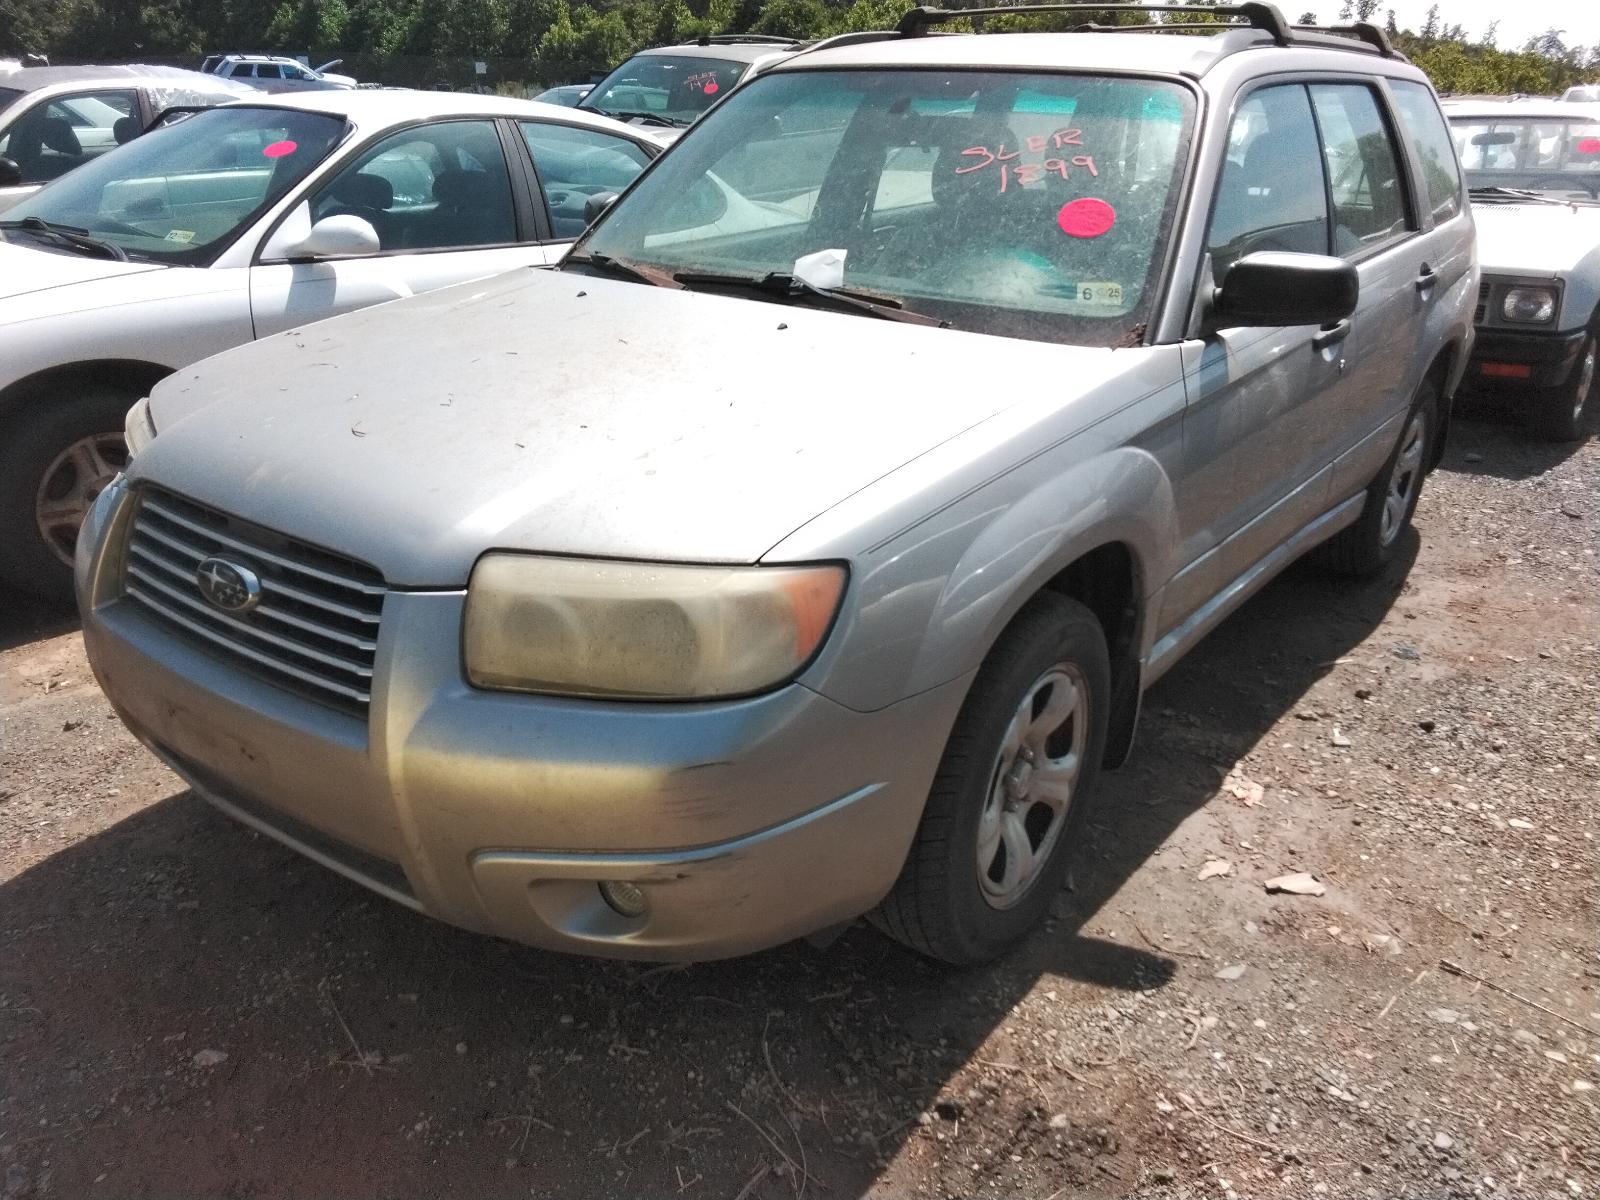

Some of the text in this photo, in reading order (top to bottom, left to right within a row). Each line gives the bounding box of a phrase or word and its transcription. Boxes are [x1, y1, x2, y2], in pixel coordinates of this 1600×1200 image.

[955, 128, 1084, 174] SLER
[1082, 287, 1121, 301] 6 25
